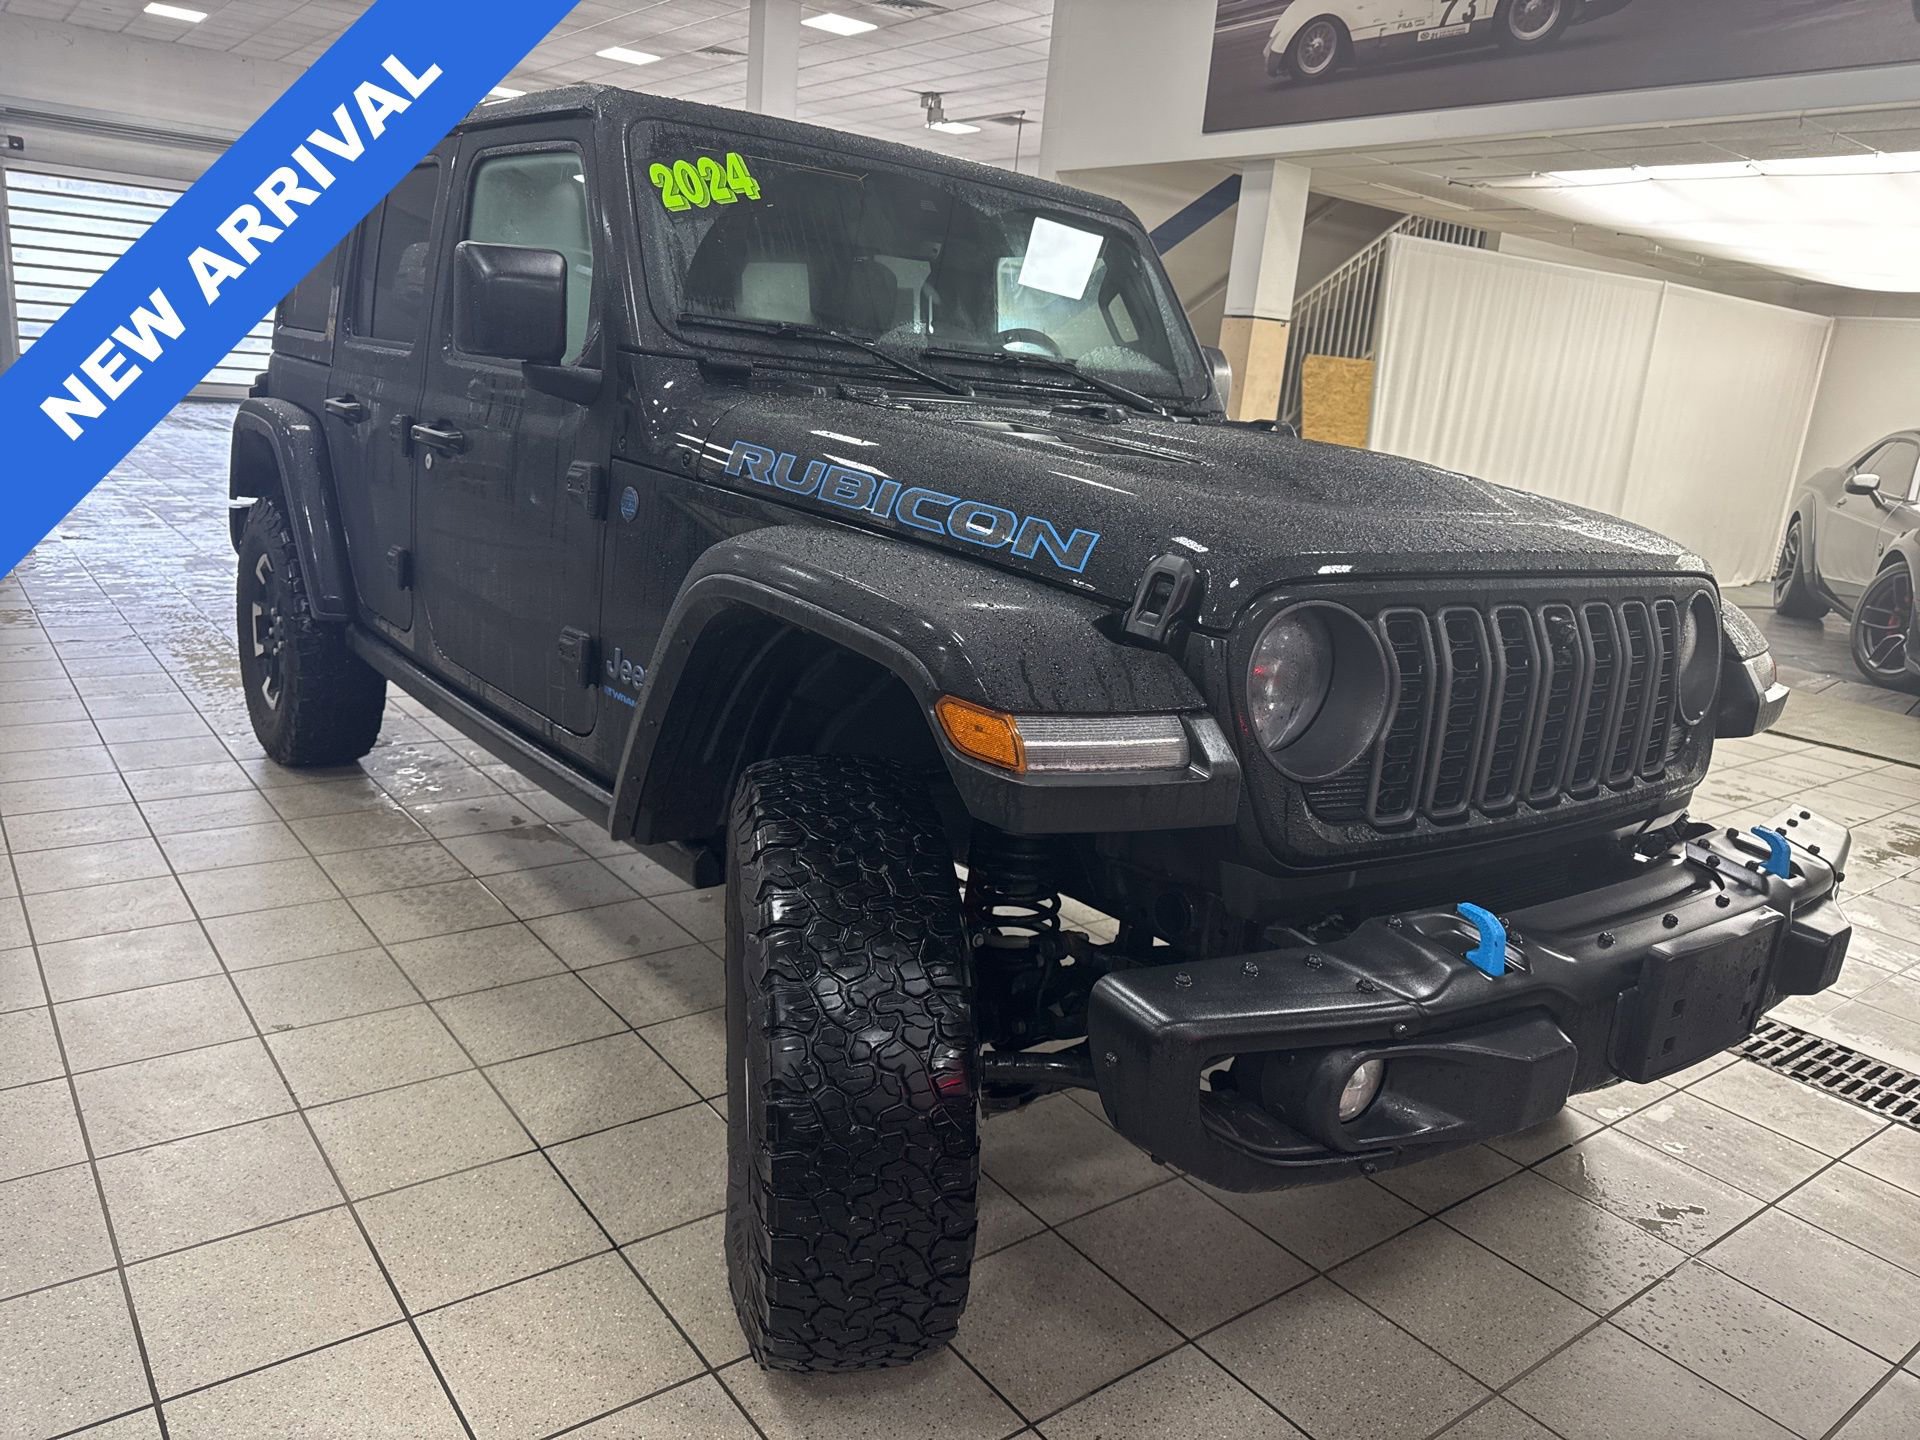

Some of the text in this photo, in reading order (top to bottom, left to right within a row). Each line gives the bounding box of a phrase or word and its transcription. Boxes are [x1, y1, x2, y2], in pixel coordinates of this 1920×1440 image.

[1440, 0, 1477, 27] 73
[649, 152, 761, 212] 2024
[724, 440, 1100, 573] RUBICON
[606, 647, 648, 691] Jee
